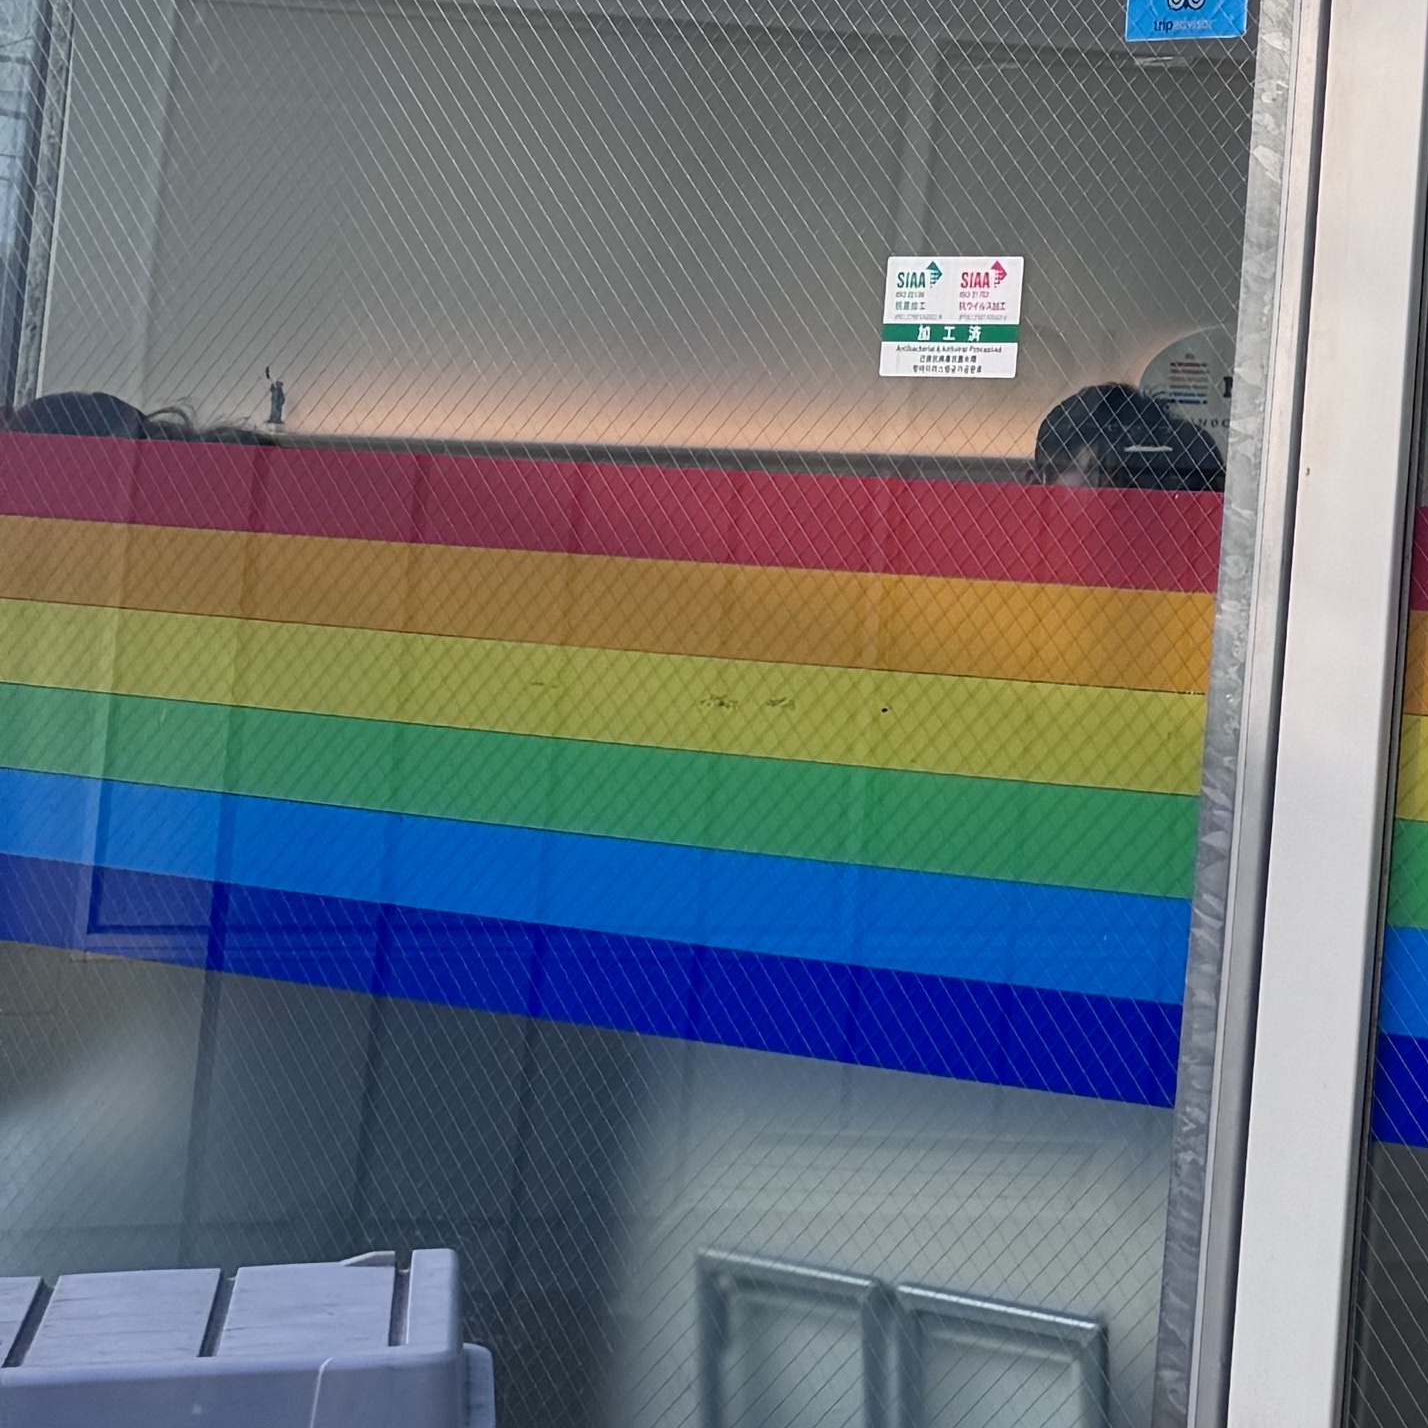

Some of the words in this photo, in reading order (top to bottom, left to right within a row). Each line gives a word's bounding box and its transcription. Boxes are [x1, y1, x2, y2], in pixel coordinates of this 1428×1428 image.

[897, 271, 926, 288] SIAA
[960, 271, 990, 288] SIAA
[917, 324, 982, 341] 加工済
